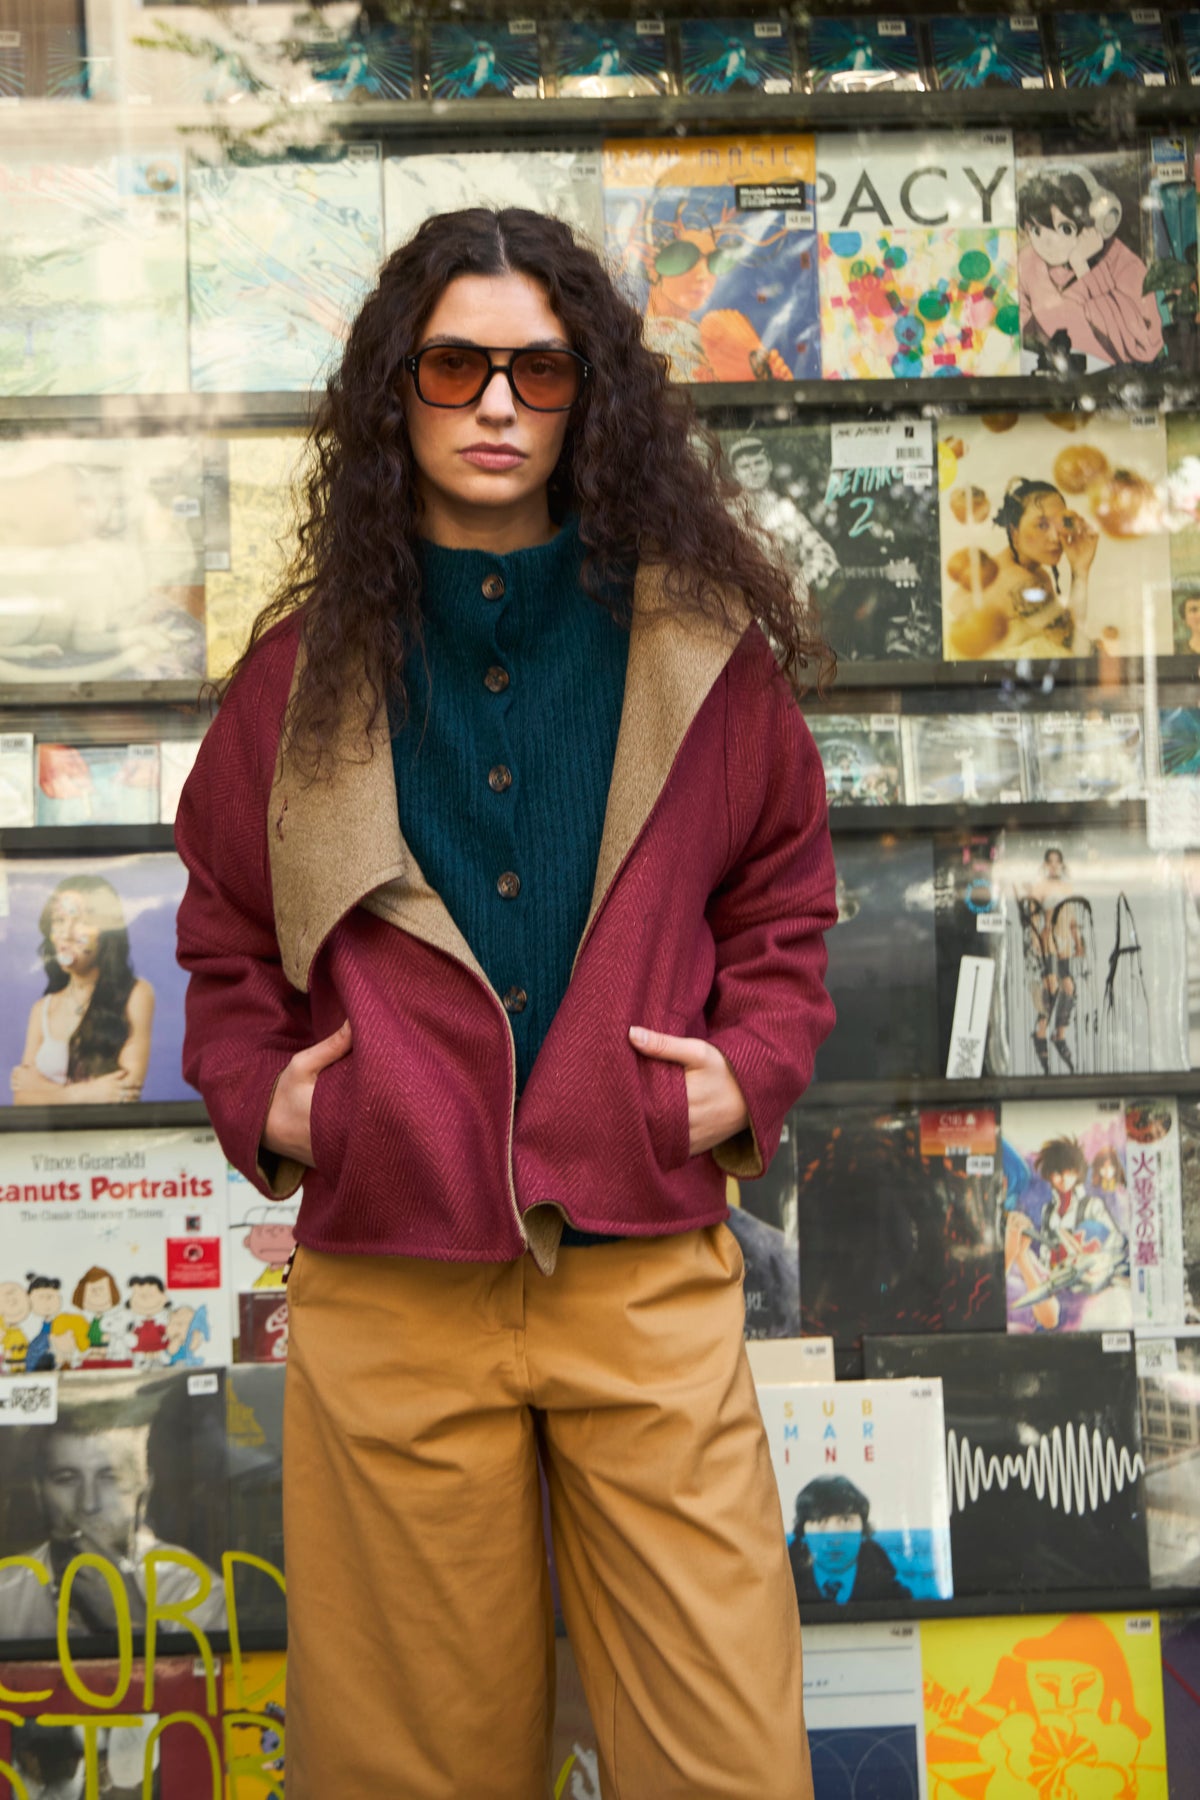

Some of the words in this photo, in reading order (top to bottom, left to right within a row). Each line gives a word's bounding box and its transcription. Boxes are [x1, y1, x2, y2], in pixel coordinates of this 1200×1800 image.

[699, 144, 796, 167] MAGIC
[848, 497, 874, 539] 2
[31, 1153, 76, 1171] Vince
[78, 1151, 146, 1170] Guaraldi
[90, 1171, 214, 1200] Portraits
